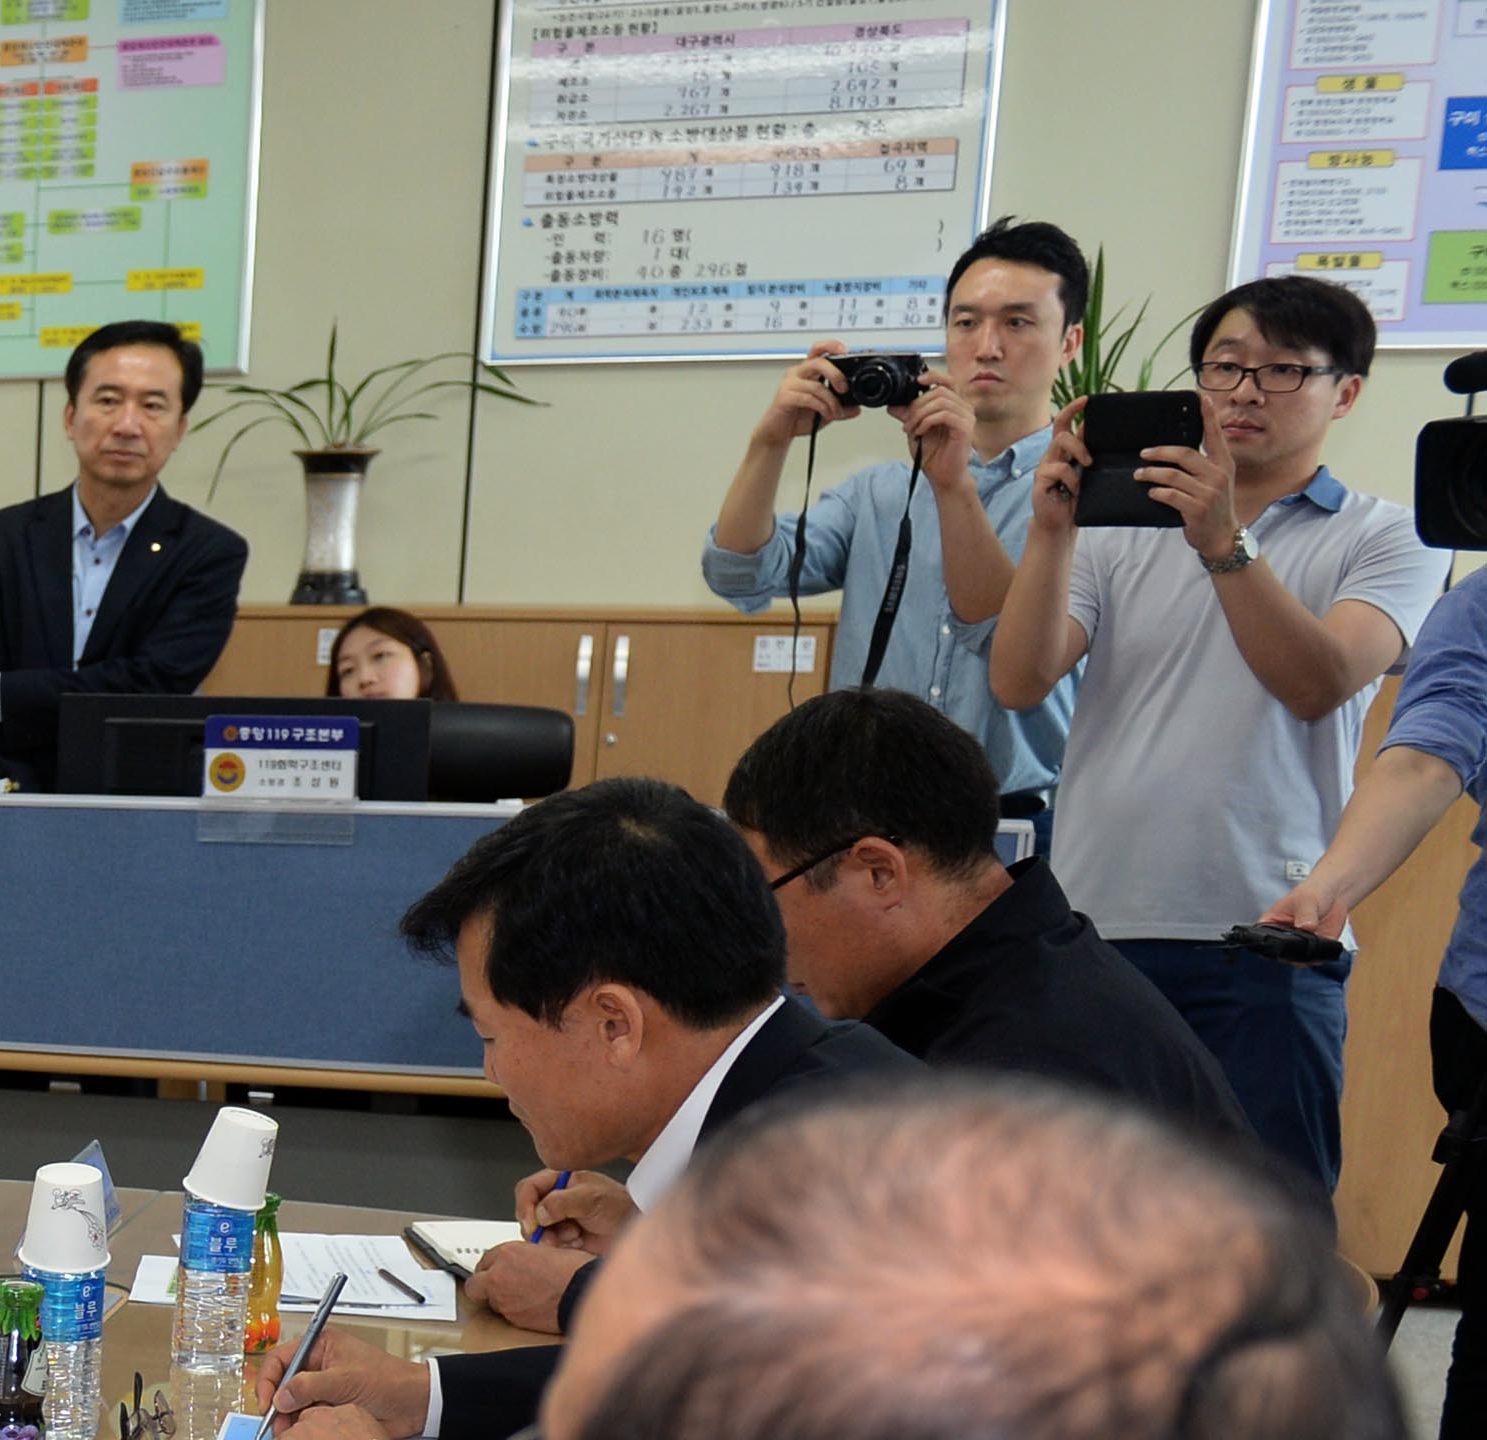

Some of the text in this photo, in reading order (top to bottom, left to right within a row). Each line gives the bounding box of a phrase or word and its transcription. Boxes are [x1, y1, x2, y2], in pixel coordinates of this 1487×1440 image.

[854, 23, 902, 38] 경상북도
[675, 33, 736, 48] 대구광역시
[541, 210, 619, 230] 출동소방력
[209, 1236, 238, 1254] 블루
[75, 1300, 99, 1321] 블루
